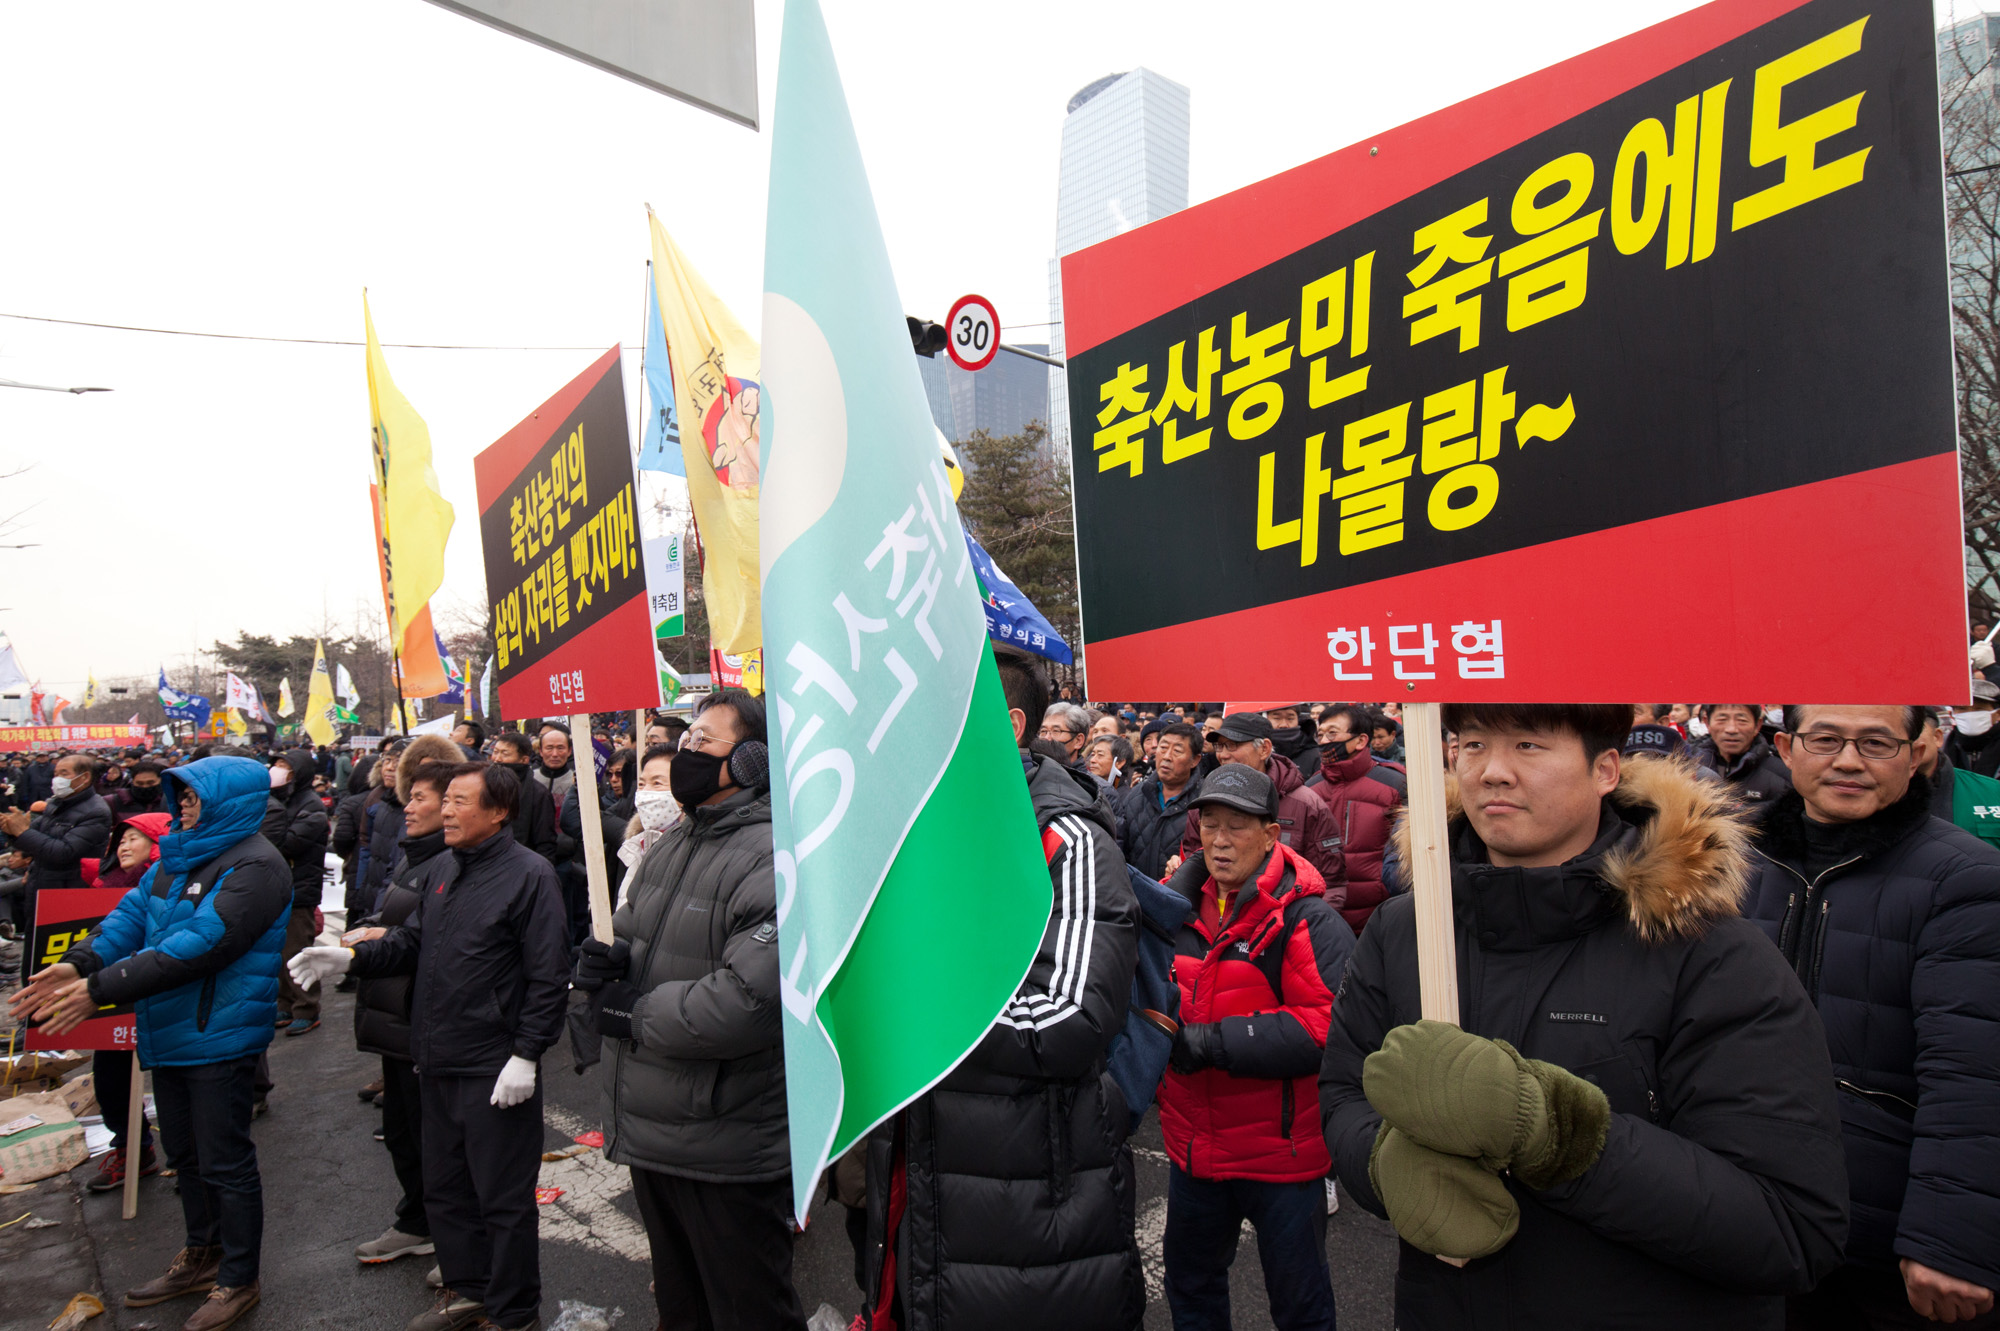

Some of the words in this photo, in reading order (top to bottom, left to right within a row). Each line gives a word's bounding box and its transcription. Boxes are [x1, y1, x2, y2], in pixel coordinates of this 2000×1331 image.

[1092, 249, 1376, 477] 축산농민
[1402, 13, 1874, 352] 죽음에도
[956, 315, 989, 351] 30
[510, 422, 588, 567] 축산농민의
[1255, 365, 1577, 568] 나몰랑~
[495, 586, 523, 671] 삶의
[522, 544, 570, 644] 자리를
[570, 482, 637, 613] 뺏지마!
[549, 669, 585, 705] 한단협
[1326, 619, 1507, 682] 한단협
[1549, 1012, 1607, 1023] MERRELL
